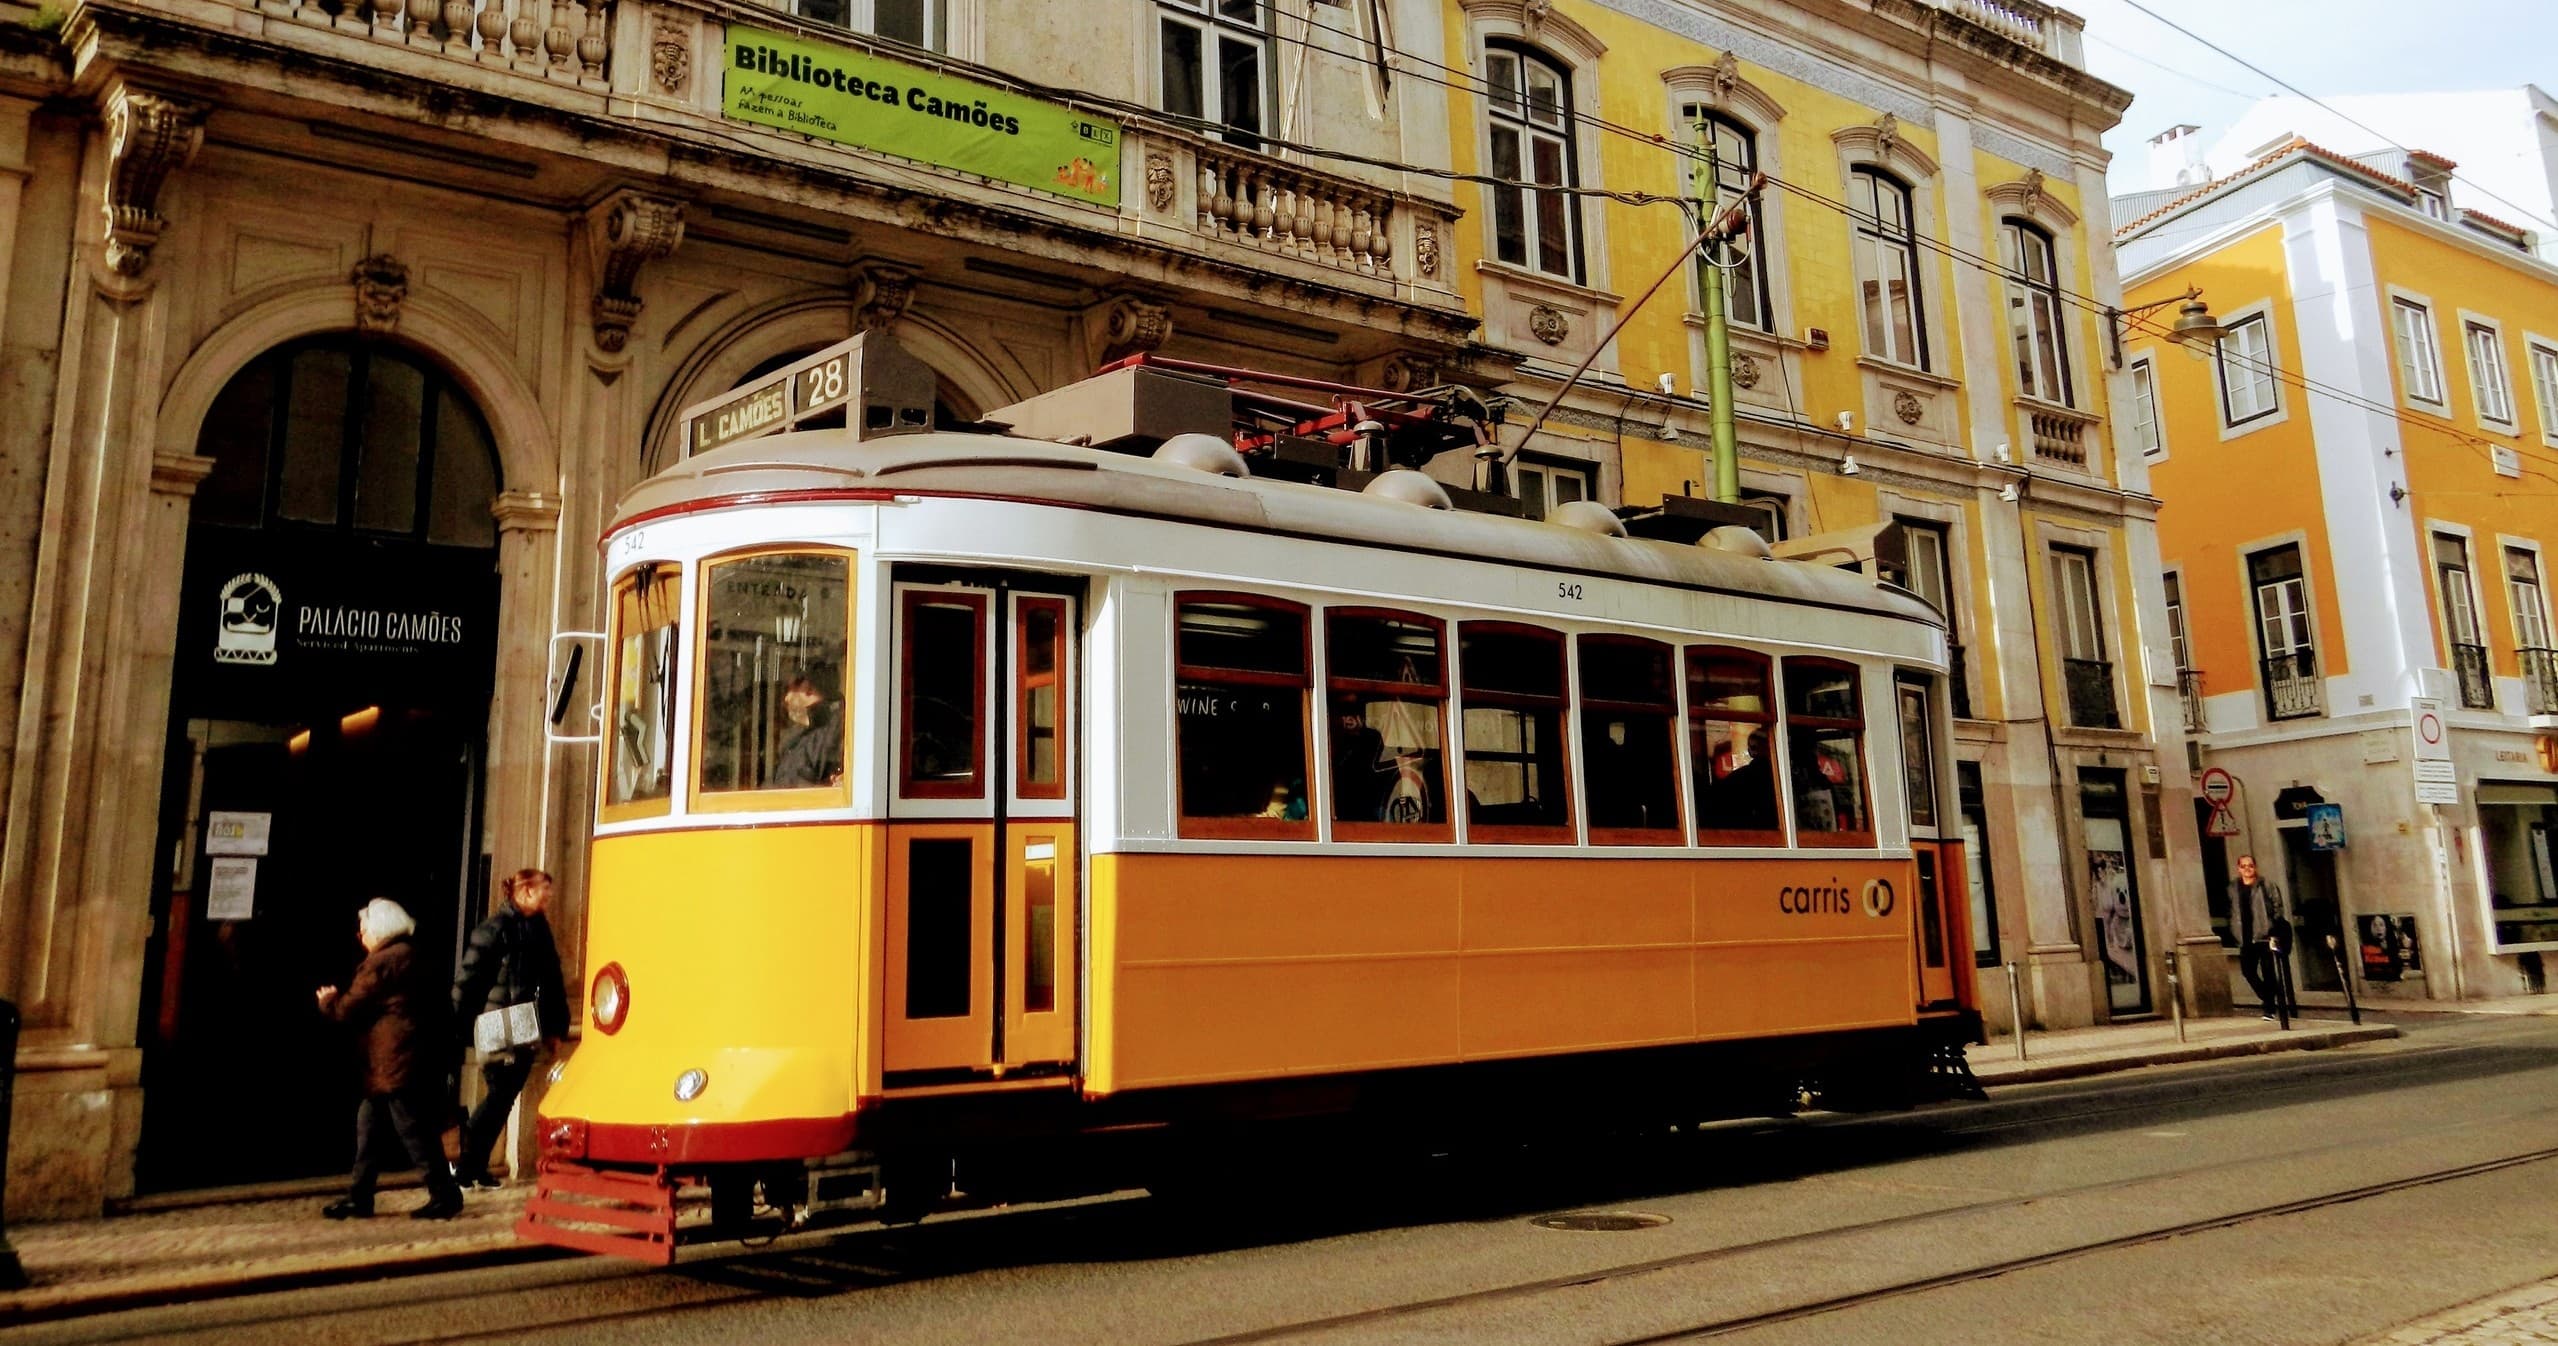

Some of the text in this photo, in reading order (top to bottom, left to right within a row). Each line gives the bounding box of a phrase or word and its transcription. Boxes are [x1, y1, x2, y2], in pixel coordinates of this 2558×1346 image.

[735, 44, 1020, 136] Biblioteca Camões
[808, 358, 843, 408] 28
[717, 390, 783, 440] CAMÕES
[624, 531, 645, 556] 542
[1558, 582, 1583, 601] 542
[298, 605, 462, 644] PALÁCIO CAMÕES
[1177, 695, 1219, 717] WINE
[1779, 876, 1851, 915] carris
